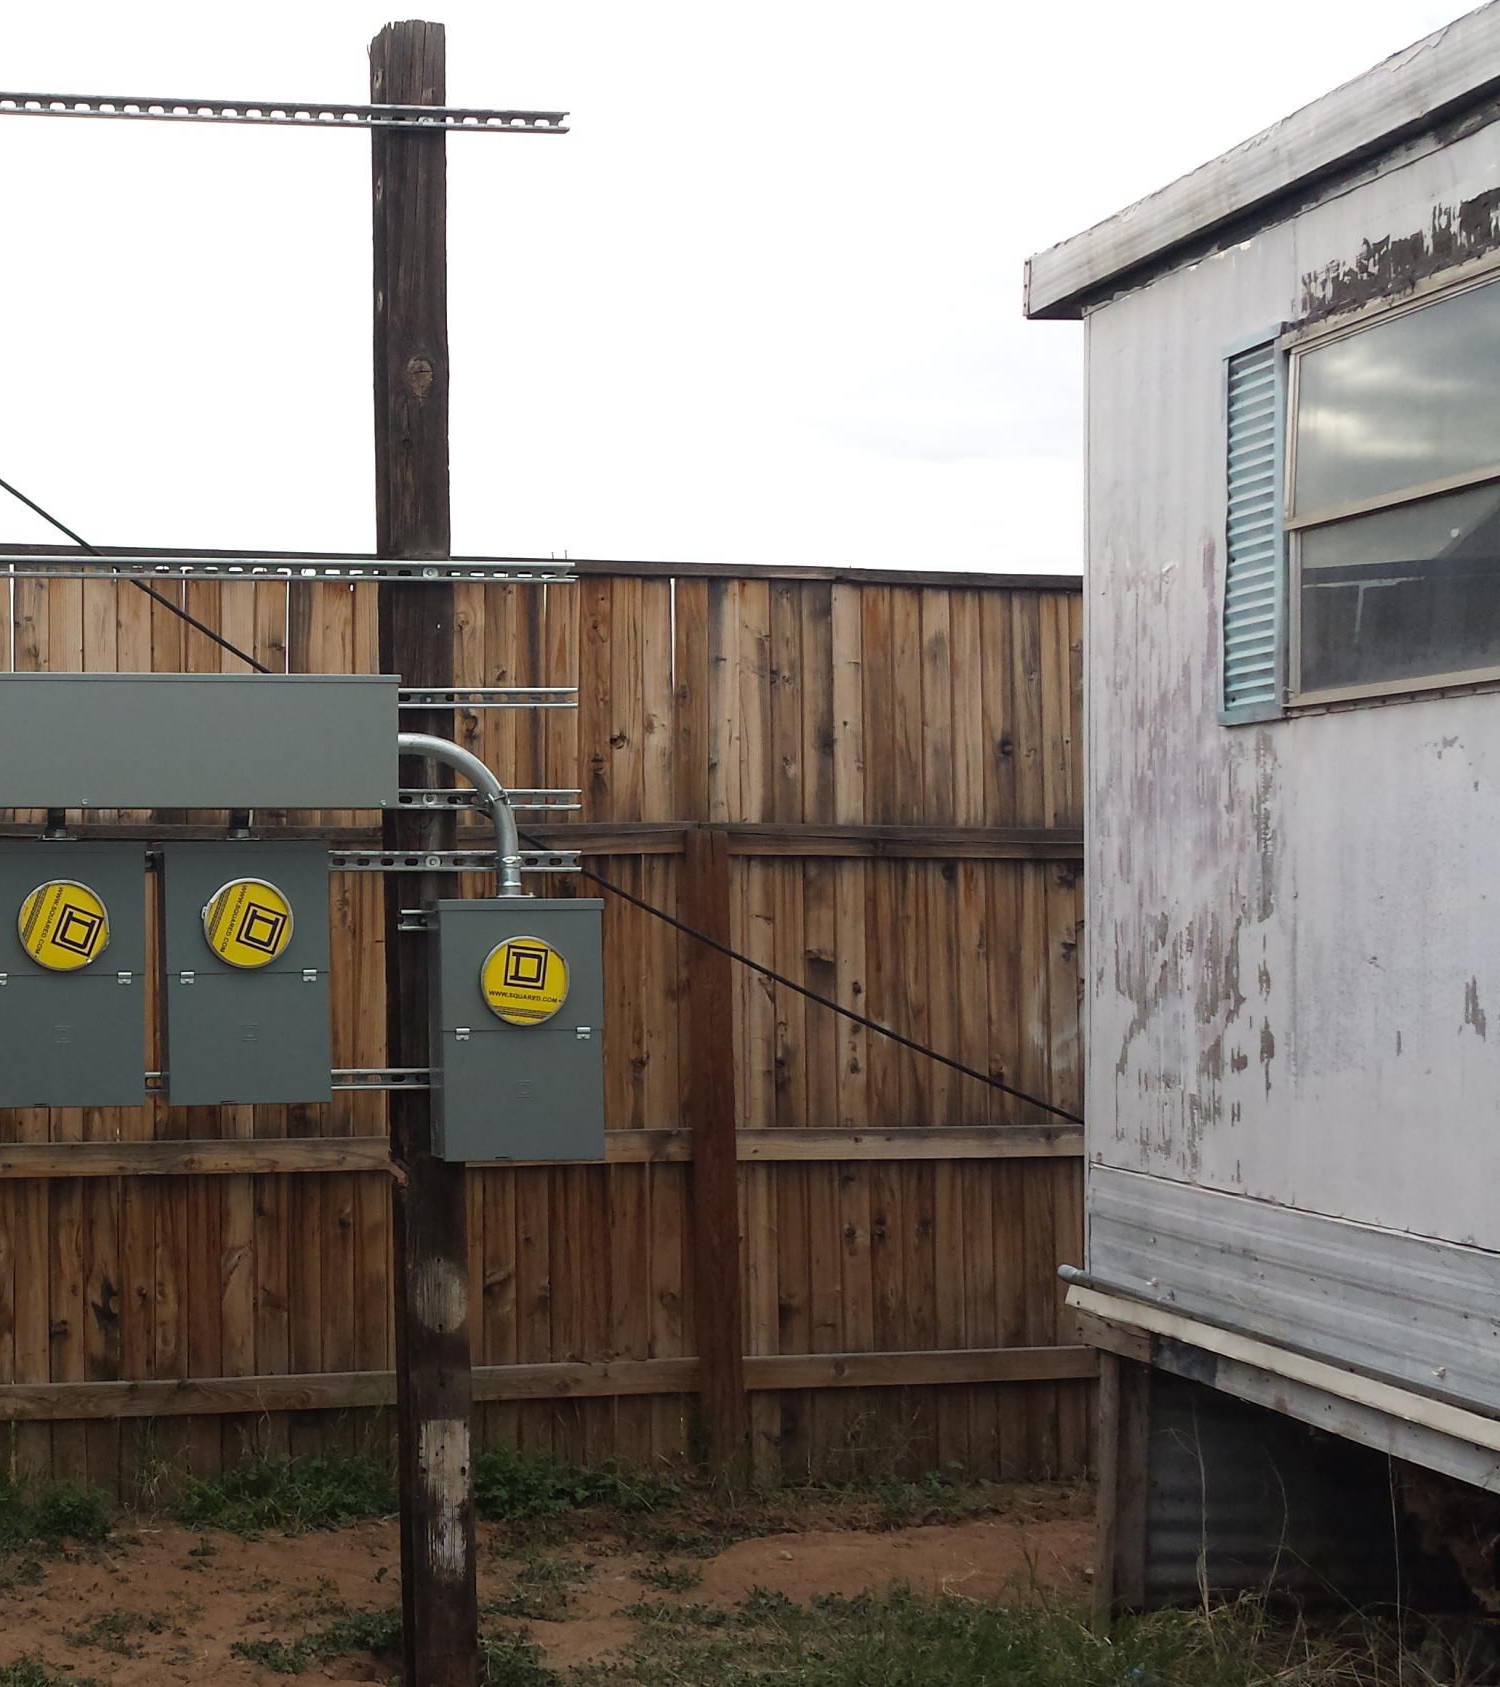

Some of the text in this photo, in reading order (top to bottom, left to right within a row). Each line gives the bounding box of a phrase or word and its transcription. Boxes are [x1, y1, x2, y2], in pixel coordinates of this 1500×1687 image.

[34, 887, 64, 955] WWW.SQUARED.COM
[219, 885, 248, 953] WWW.SQUARED.COM
[489, 990, 558, 1003] WWW.SQUARED.COM
